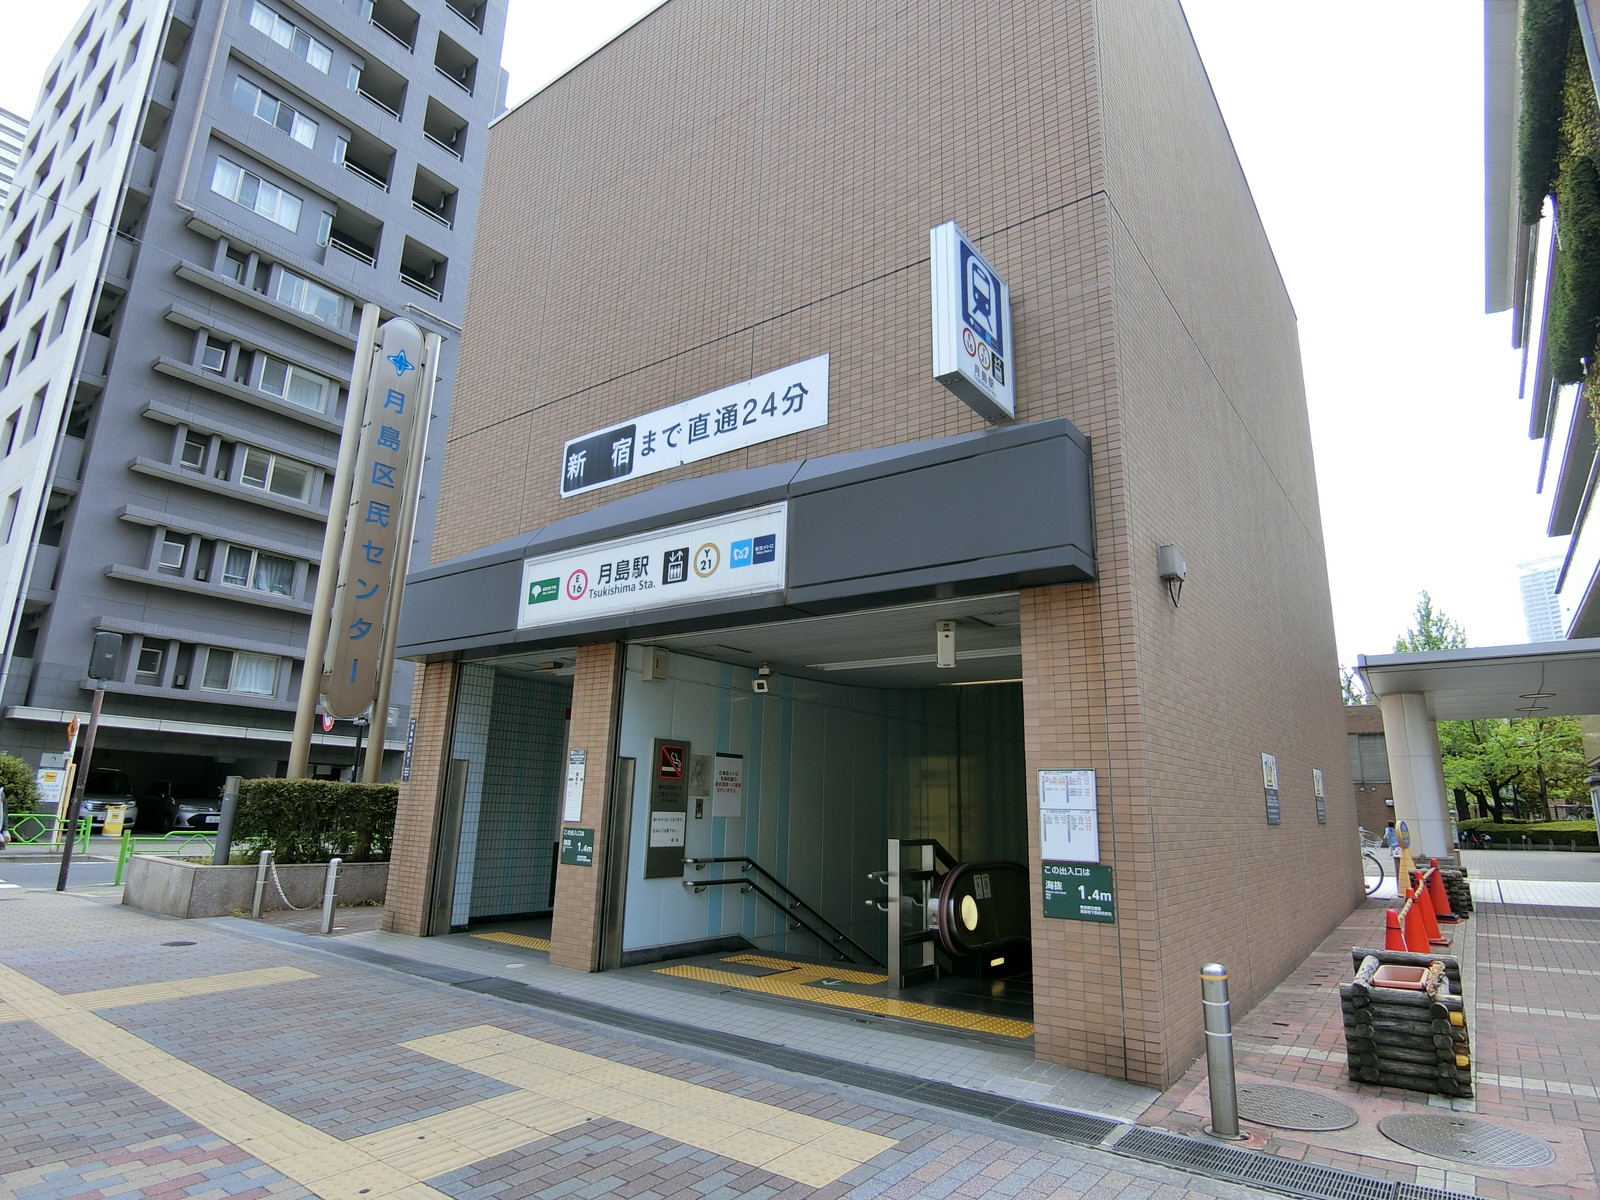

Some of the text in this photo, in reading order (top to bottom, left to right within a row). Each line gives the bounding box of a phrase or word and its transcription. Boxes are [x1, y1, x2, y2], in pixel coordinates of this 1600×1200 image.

[350, 388, 406, 682] 月島区民センター
[704, 548, 711, 558] Y
[598, 555, 650, 585] 月島駅
[700, 559, 712, 571] 21
[575, 574, 580, 583] E
[572, 584, 582, 594] 16
[589, 579, 656, 599] Tsukishima Sta.
[577, 842, 593, 853] 1.4m
[1044, 865, 1091, 877] この出入口は
[1045, 880, 1063, 891] 海抜
[1078, 885, 1112, 902] 1.4m
